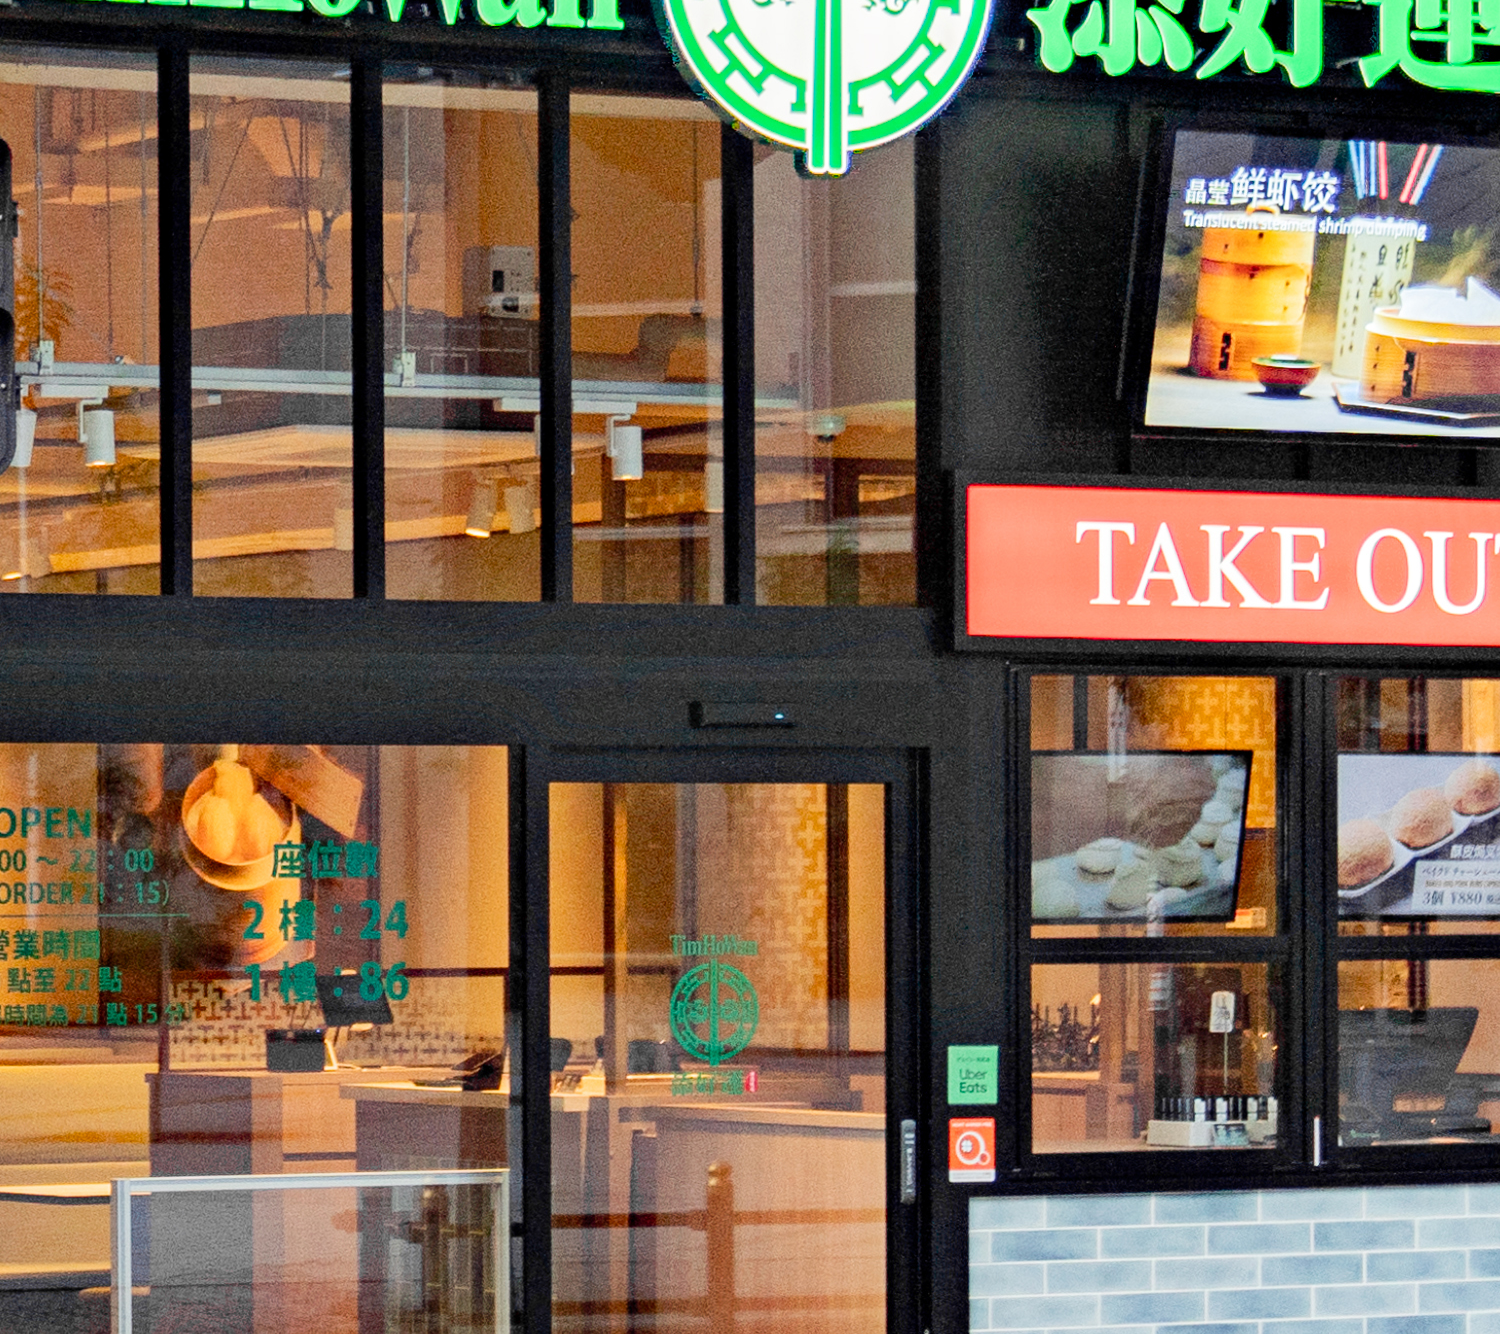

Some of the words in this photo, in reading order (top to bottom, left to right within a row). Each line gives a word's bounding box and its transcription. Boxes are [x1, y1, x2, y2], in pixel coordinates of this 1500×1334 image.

[1185, 166, 1340, 214] 晶莹鲜虾饺
[1183, 210, 1258, 231] Translucent
[1260, 215, 1317, 234] steamed
[1318, 216, 1363, 238] shrimp
[1365, 217, 1427, 242] dumpling
[1075, 521, 1330, 611] TAKE
[959, 1068, 988, 1081] Uber
[959, 1081, 988, 1094] Eats
